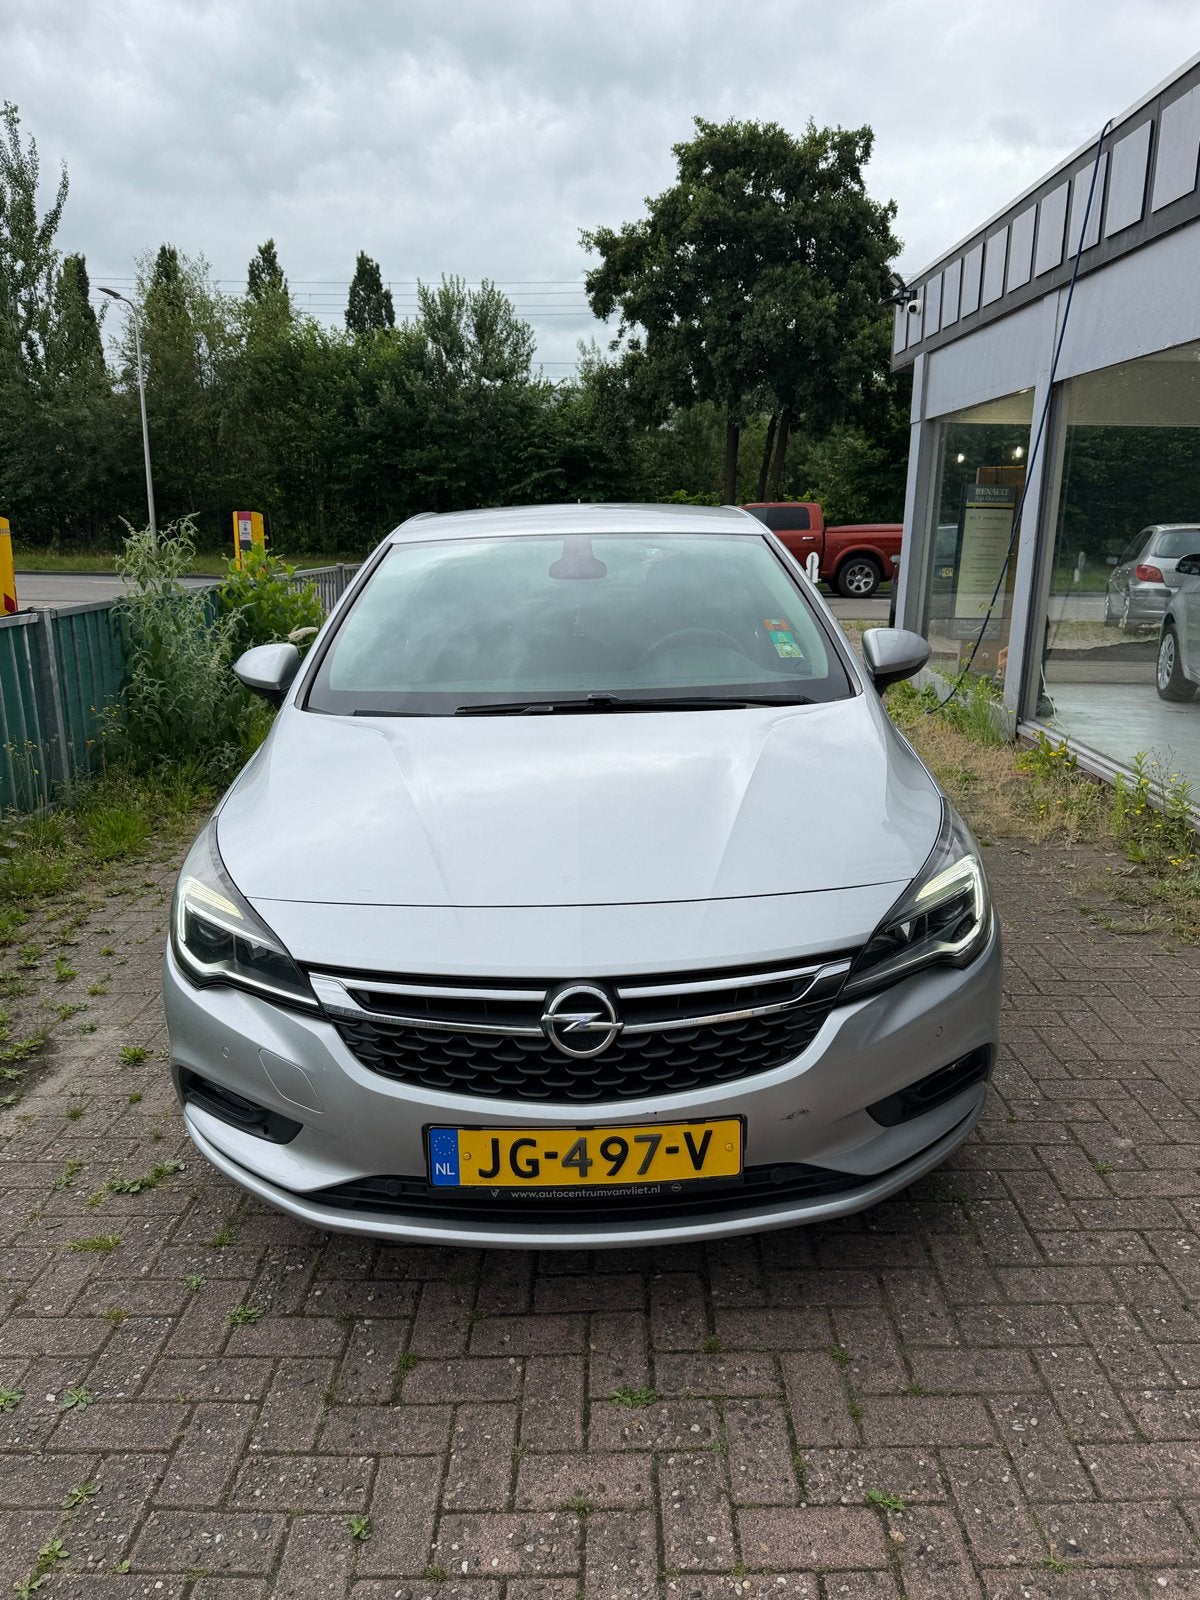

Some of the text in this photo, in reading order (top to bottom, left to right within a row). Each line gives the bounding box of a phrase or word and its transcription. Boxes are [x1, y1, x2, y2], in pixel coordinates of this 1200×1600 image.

[975, 487, 1010, 496] RENAULT
[478, 1129, 713, 1179] JG-497-V
[435, 1162, 456, 1176] NL
[510, 1184, 661, 1199] www.autocentrumvanvliet.nl
